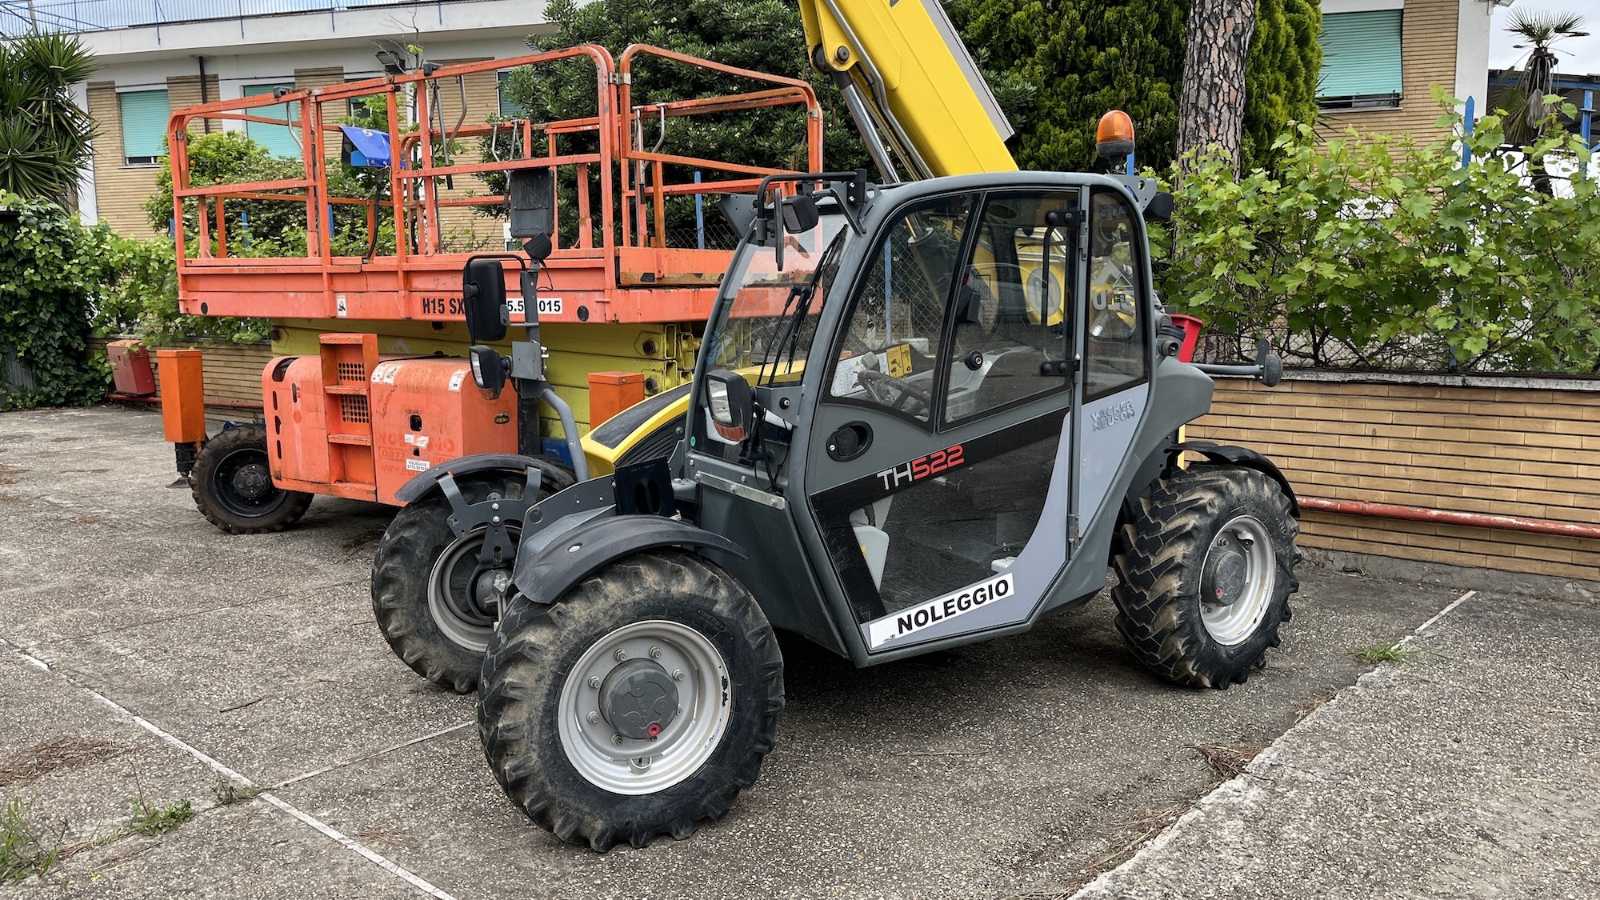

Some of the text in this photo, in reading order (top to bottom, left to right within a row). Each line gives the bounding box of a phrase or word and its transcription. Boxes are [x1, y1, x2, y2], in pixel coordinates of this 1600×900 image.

[422, 298, 446, 314] H15
[877, 443, 965, 491] TH522
[897, 579, 1009, 635] NOLEGGIO
